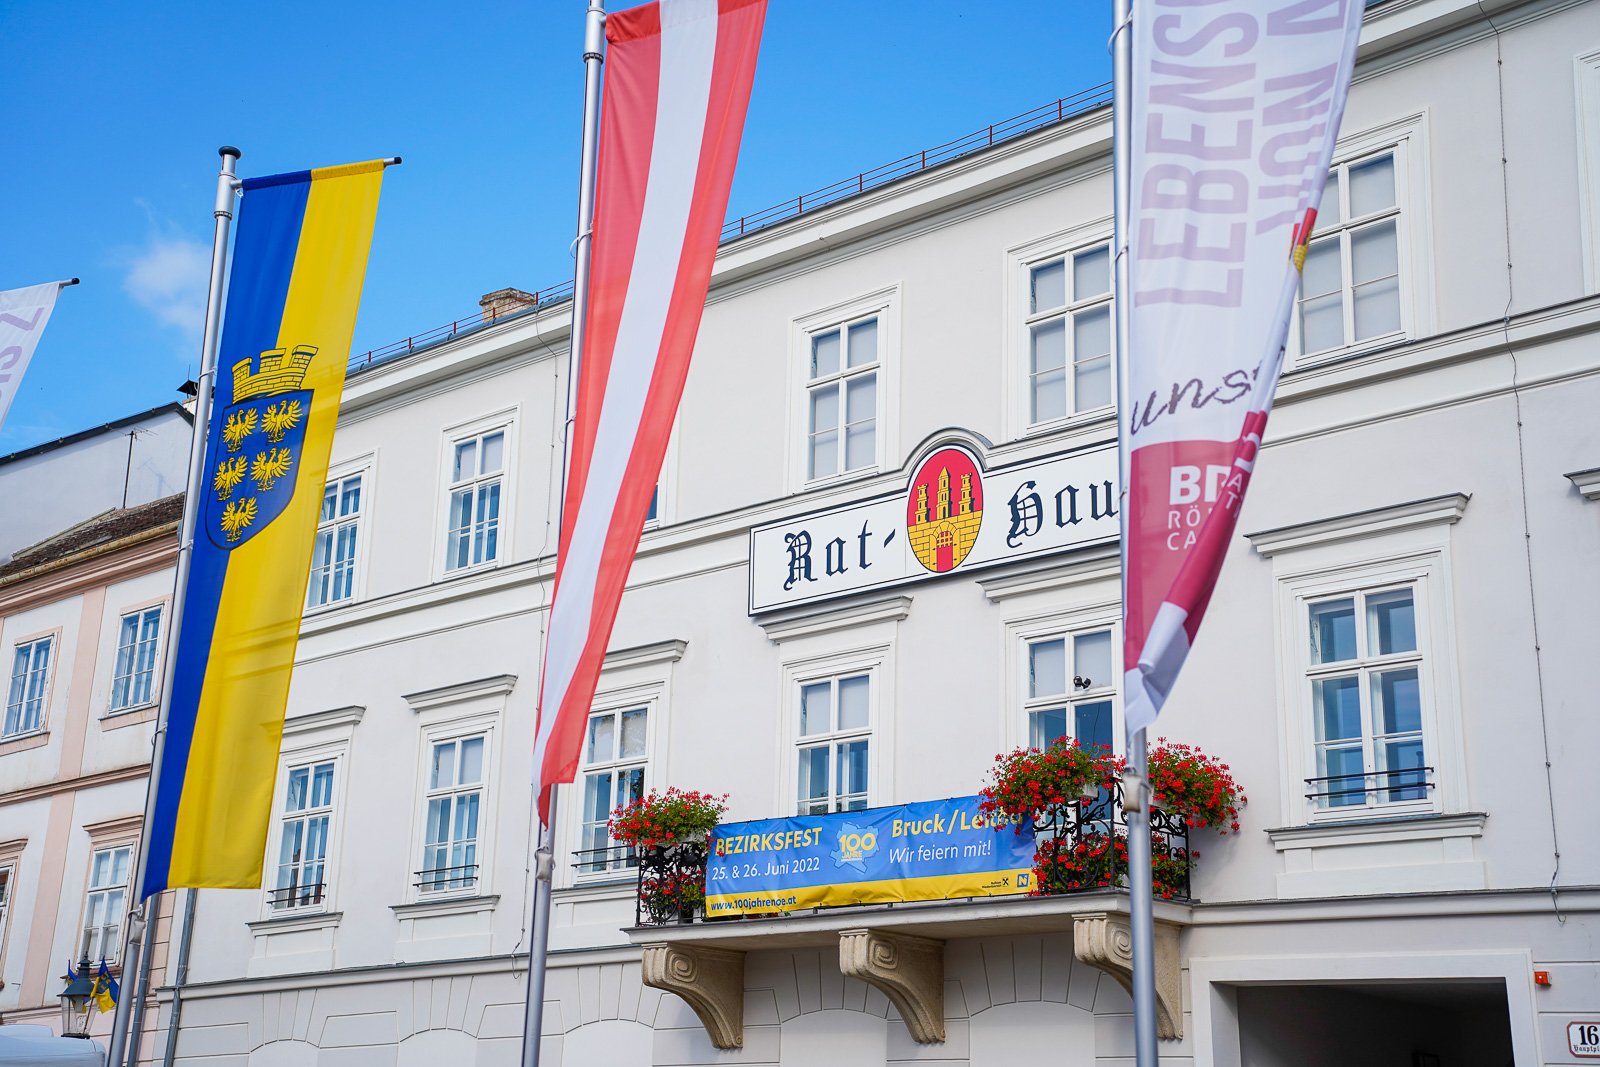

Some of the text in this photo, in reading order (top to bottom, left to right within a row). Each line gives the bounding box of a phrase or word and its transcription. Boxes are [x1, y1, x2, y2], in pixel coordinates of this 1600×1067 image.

[1134, 0, 1259, 308] LEBENS
[1130, 360, 1262, 436] uns
[1006, 479, 1119, 549] Hau
[1167, 505, 1213, 529] RÖ
[1166, 530, 1197, 550] CA
[715, 827, 823, 857] BEZIRKSFEST
[839, 833, 876, 853] 100
[889, 839, 992, 865] Wir feiern mit!
[841, 850, 863, 859] JAHRE
[712, 857, 820, 882] 25. & 26. Juni 2022
[711, 895, 797, 912] www.100jahrenoe.at
[1578, 1025, 1600, 1046] 16
